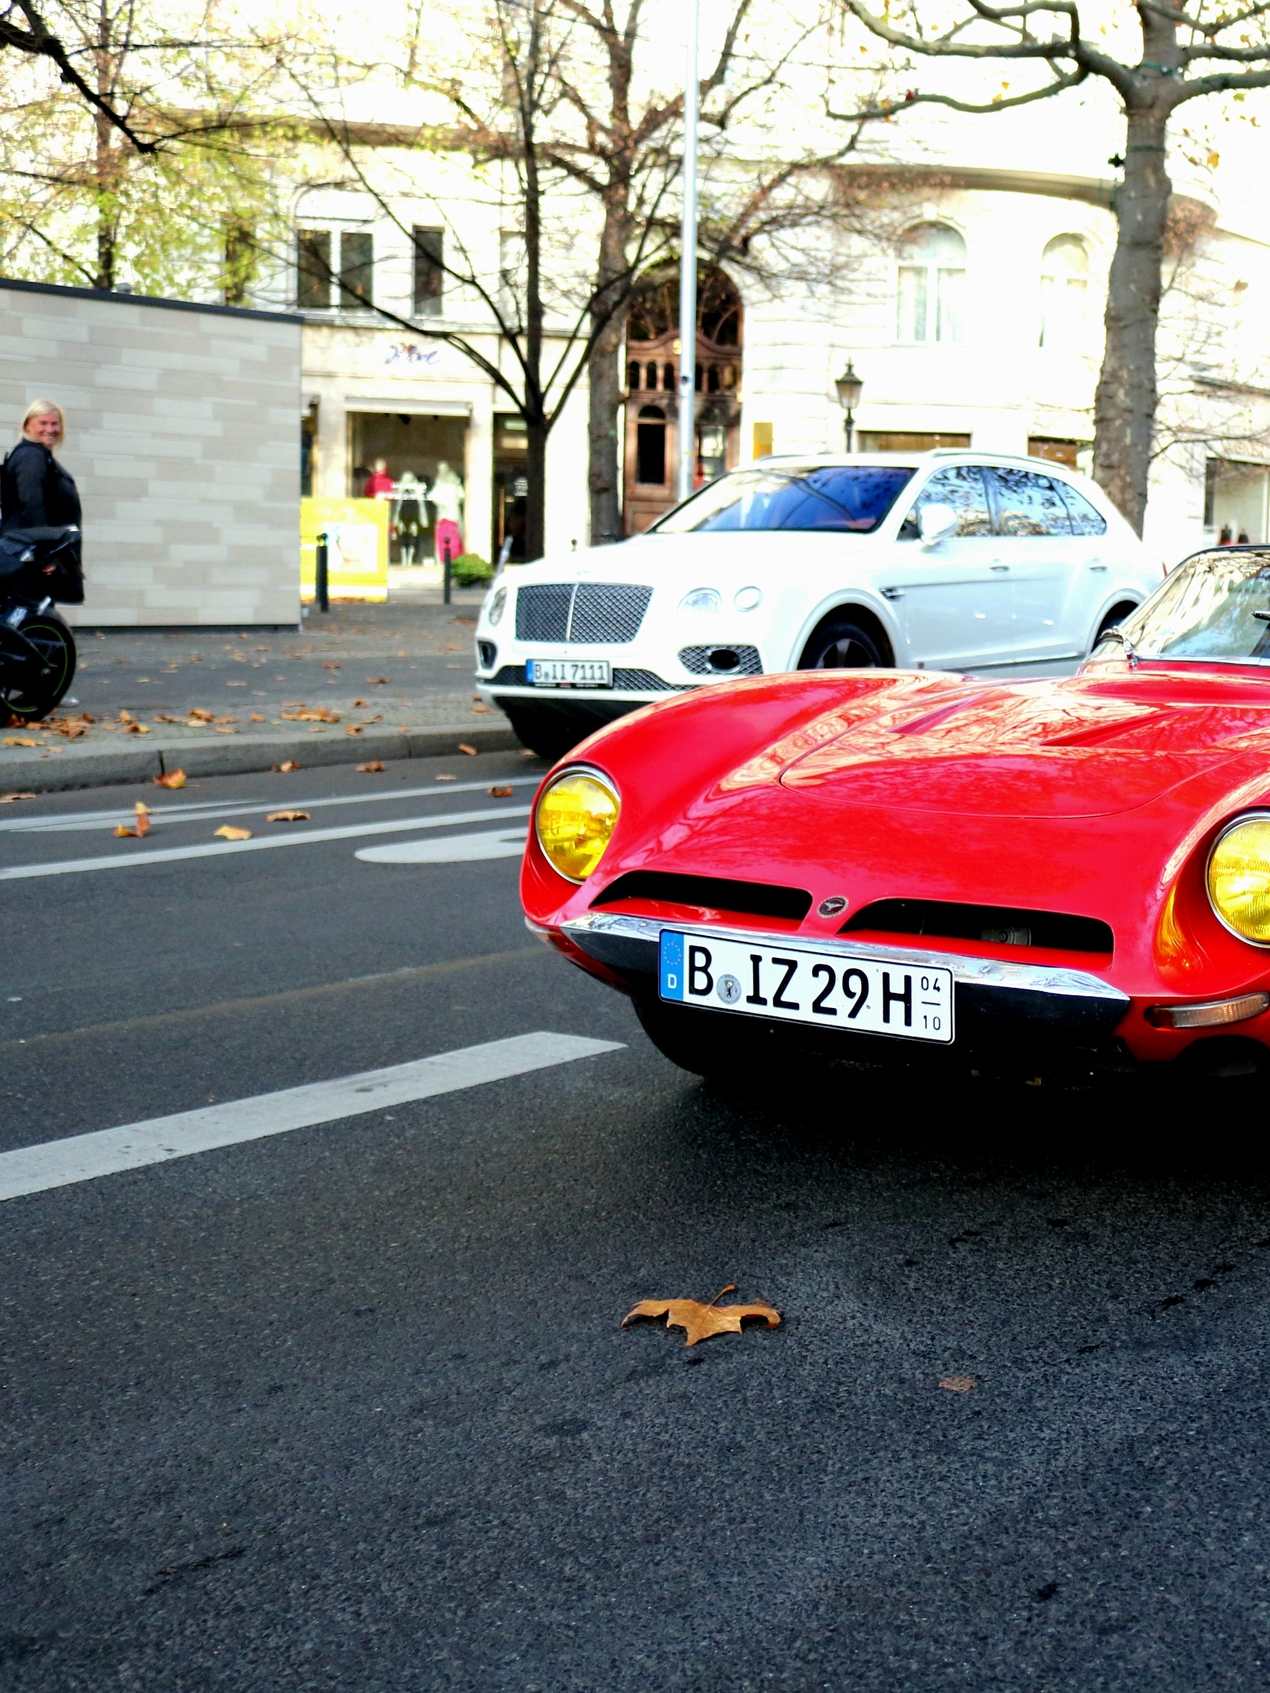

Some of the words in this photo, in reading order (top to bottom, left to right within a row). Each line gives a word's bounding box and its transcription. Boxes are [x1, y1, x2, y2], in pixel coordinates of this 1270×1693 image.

[534, 663, 542, 680] B
[571, 664, 605, 681] 7111
[688, 945, 714, 997] B
[668, 973, 677, 989] D
[920, 975, 941, 993] 04
[923, 1015, 941, 1031] 10
